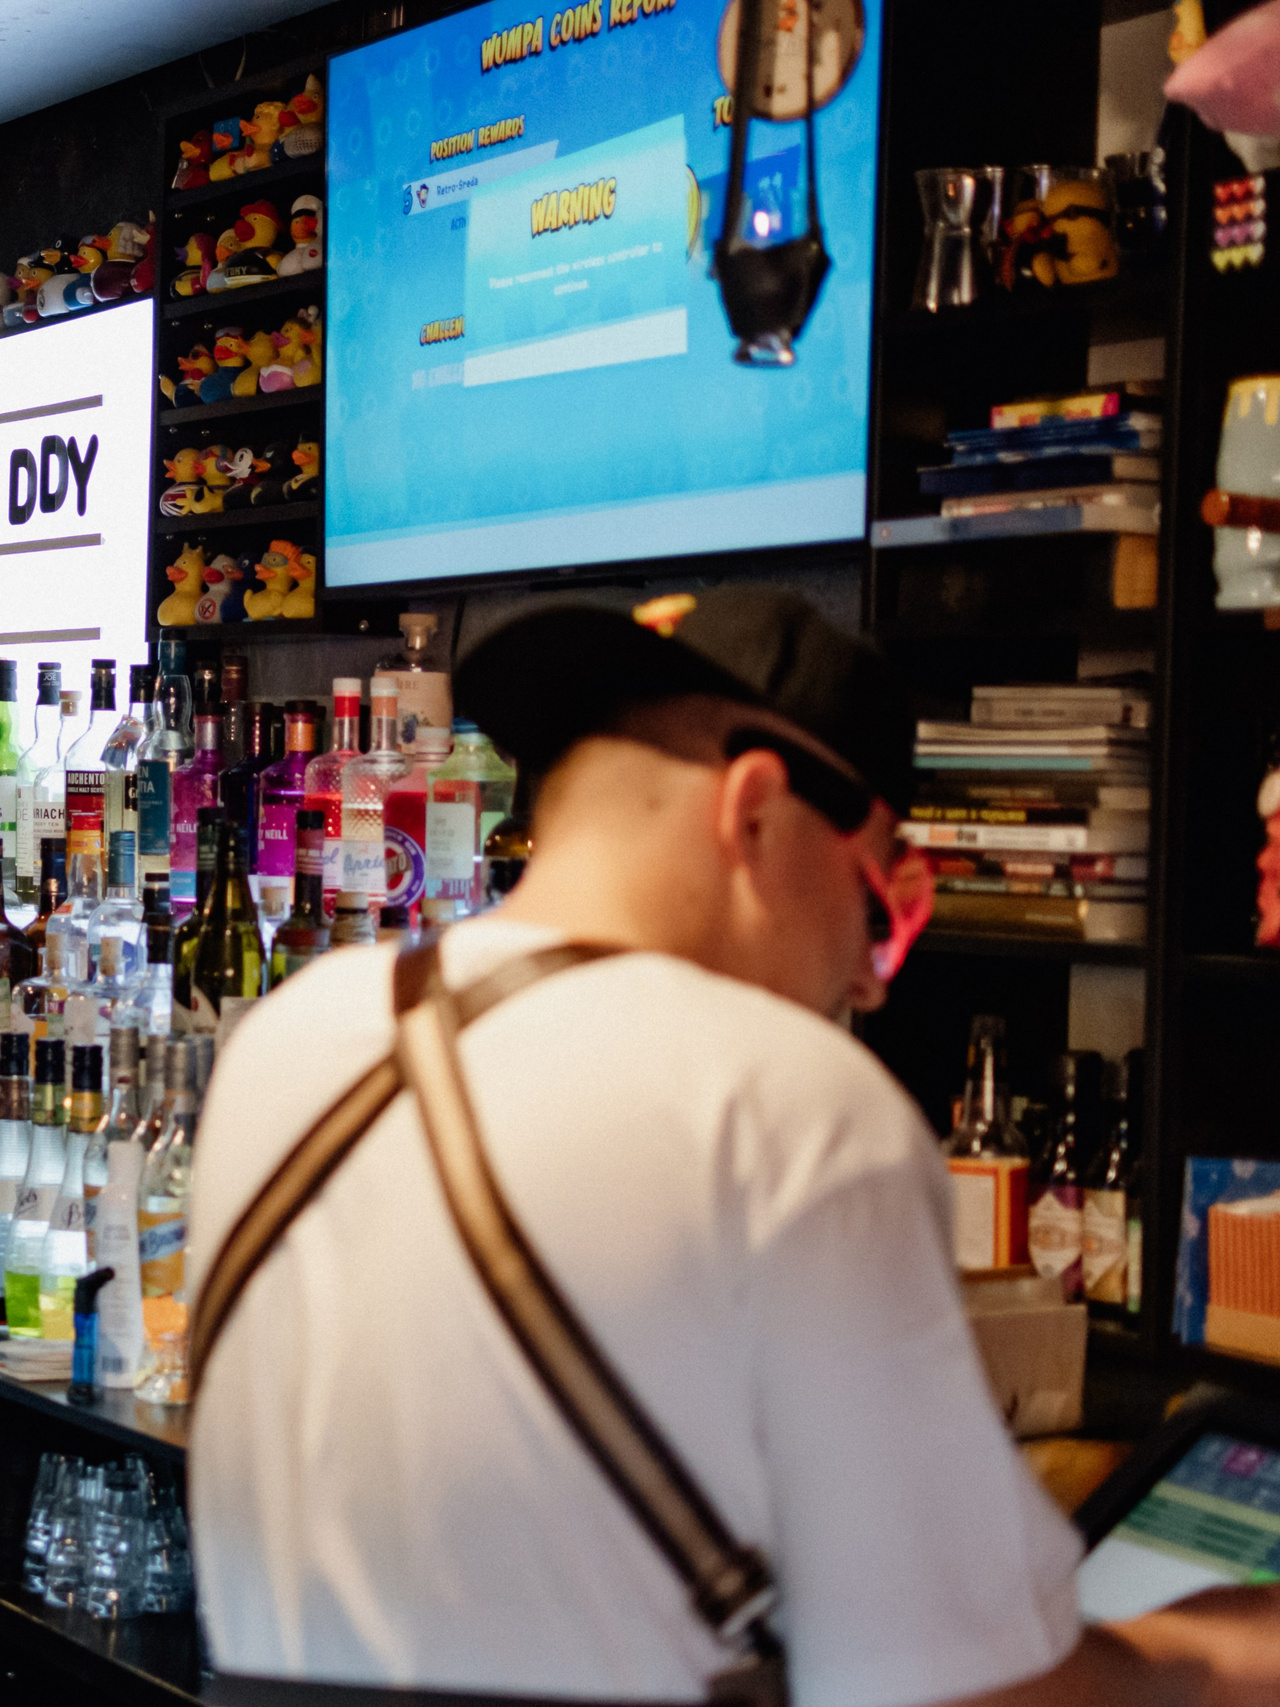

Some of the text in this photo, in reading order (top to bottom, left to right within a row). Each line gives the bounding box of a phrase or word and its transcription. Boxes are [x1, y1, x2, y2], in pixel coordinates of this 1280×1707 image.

[480, 16, 544, 75] WUMPA
[548, 0, 602, 50] COINS
[430, 114, 525, 164] POSITION REWARDS
[531, 176, 617, 239] WARNING
[67, 772, 105, 785] AUCHENTO
